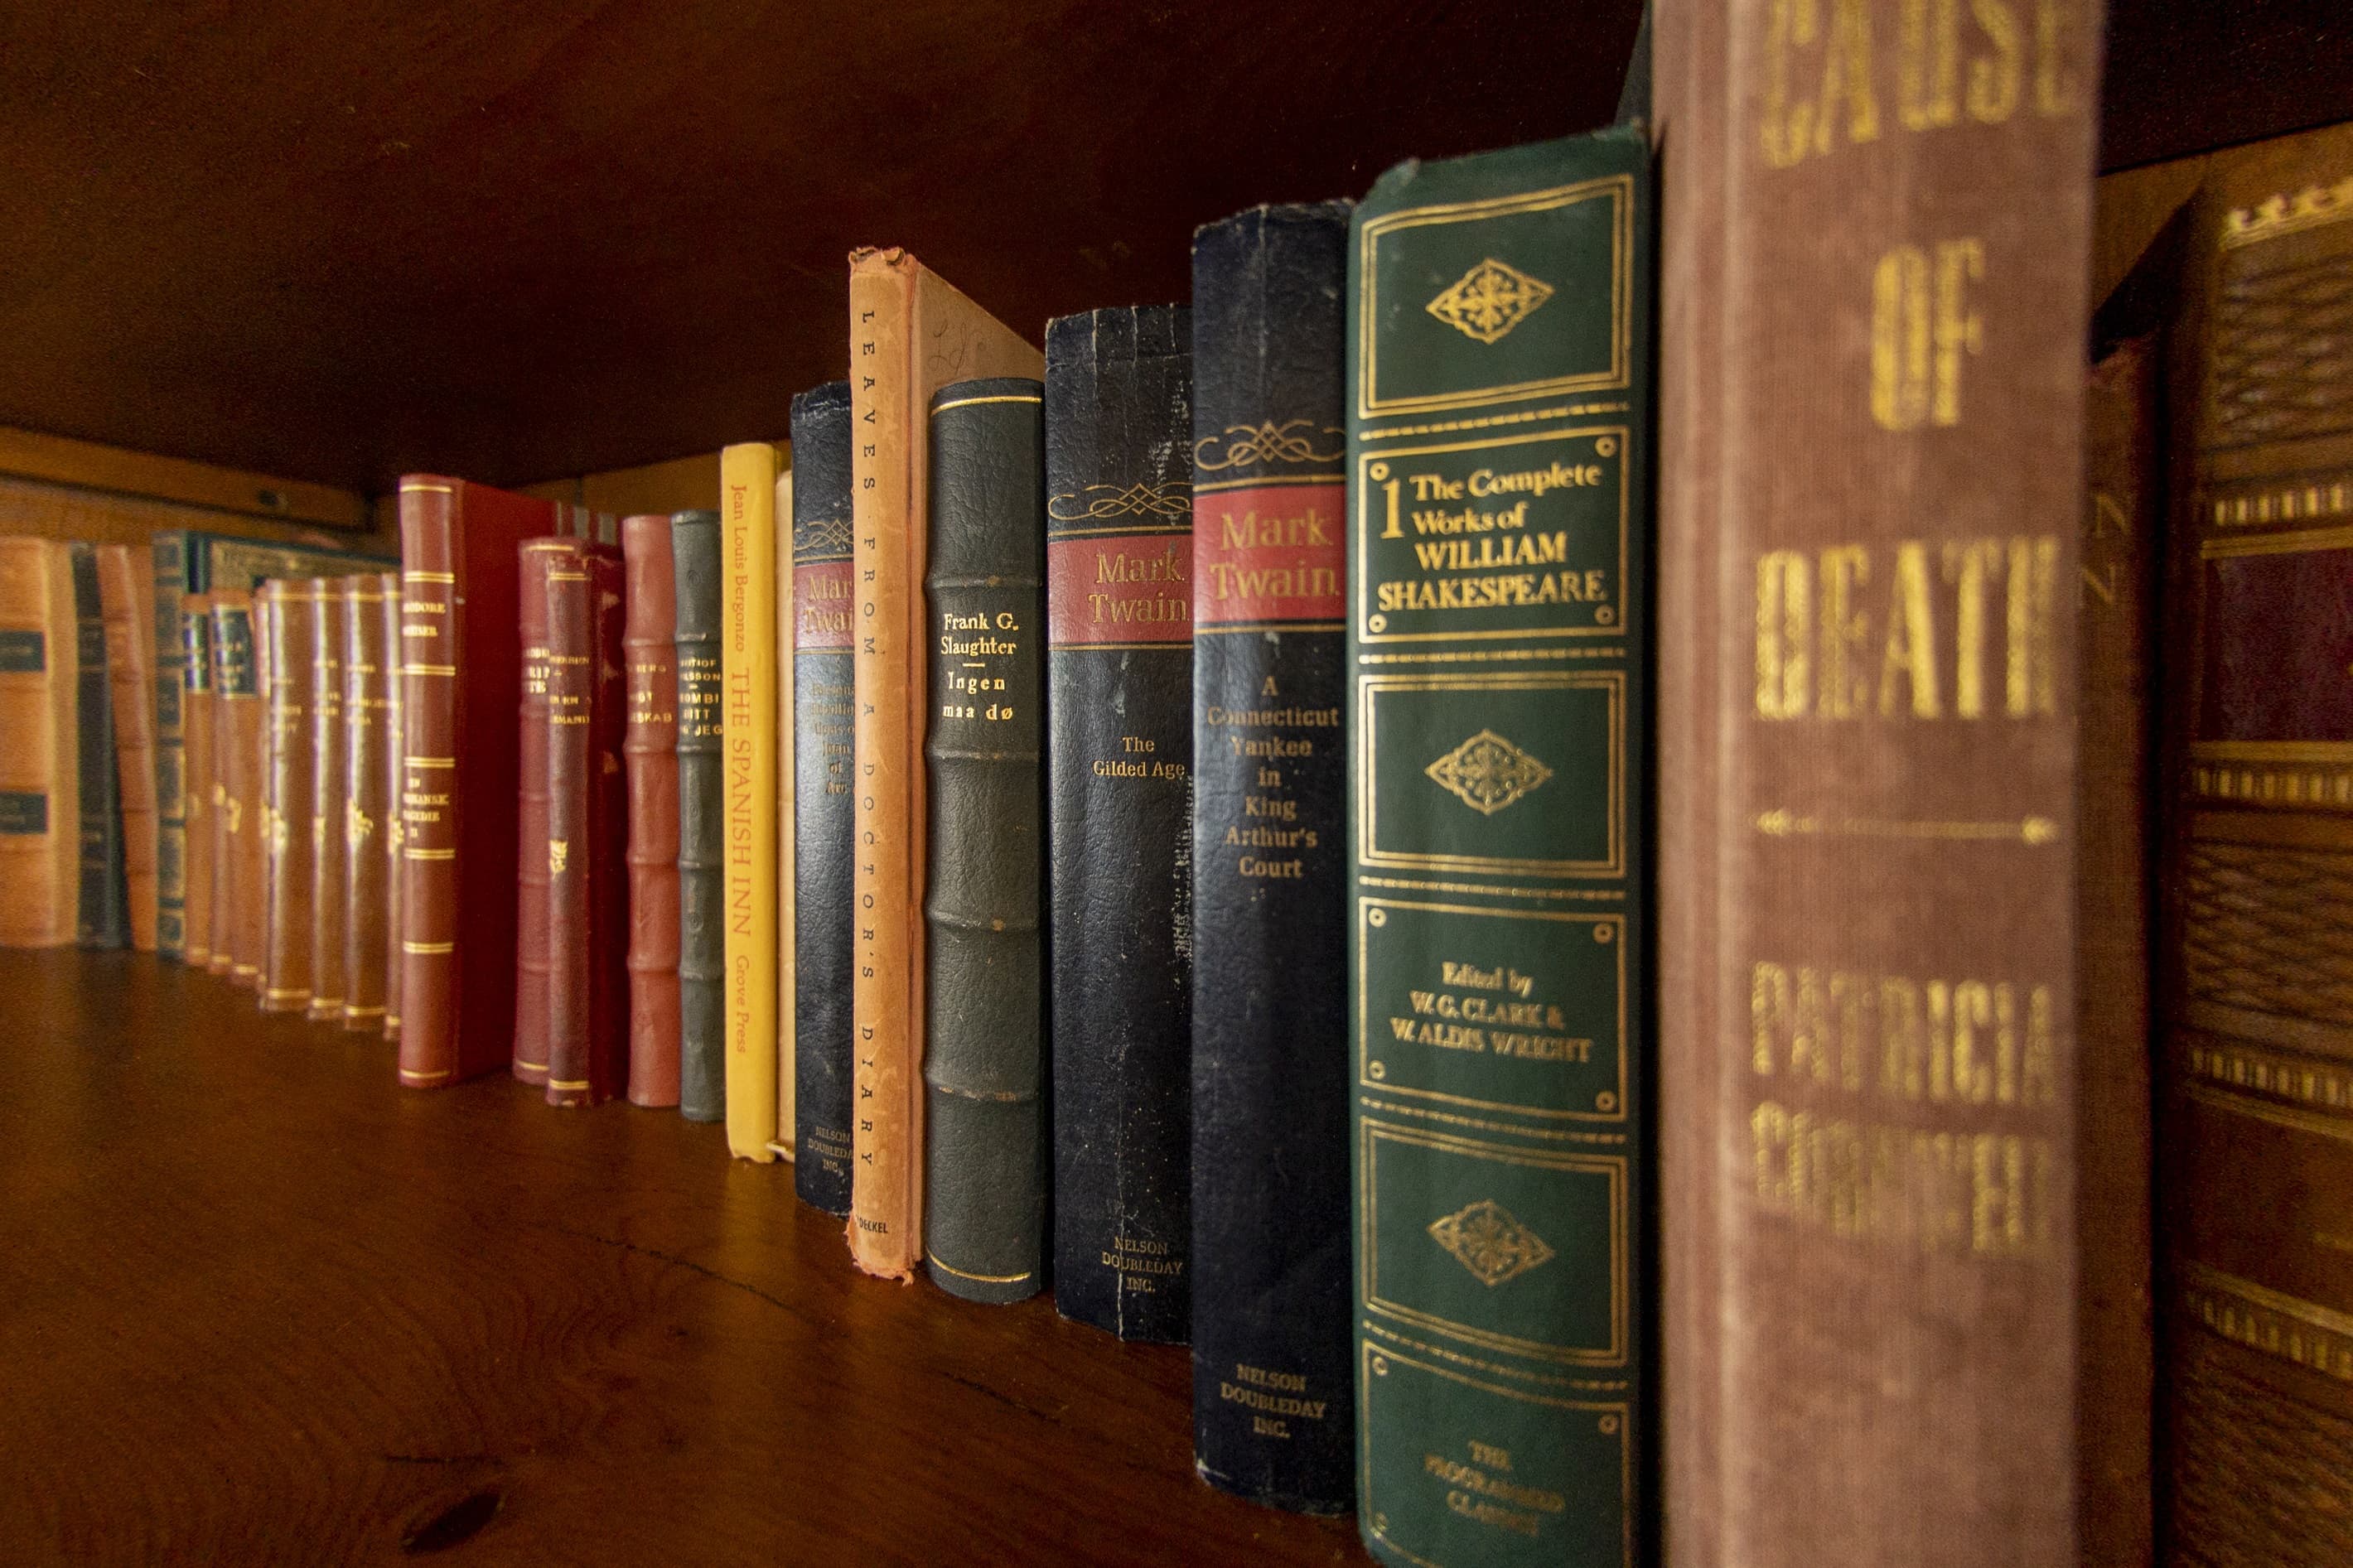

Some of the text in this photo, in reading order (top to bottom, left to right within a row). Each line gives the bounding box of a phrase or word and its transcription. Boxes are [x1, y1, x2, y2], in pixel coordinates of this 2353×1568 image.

[1758, 0, 2076, 166] CAUSE
[1871, 238, 1984, 431] OF
[1409, 461, 1602, 501] The Complete
[1380, 478, 1404, 539] 1
[1411, 500, 1530, 536] Works of
[1220, 508, 1333, 551] Mark
[1414, 531, 1568, 572] WILLIAM
[1095, 548, 1186, 584] Mark
[808, 576, 851, 602] Mar
[1209, 559, 1340, 601] Twain
[1378, 570, 1608, 612] SHAKESPEARE
[1088, 591, 1190, 623] Twain
[804, 607, 853, 634] Twai
[944, 612, 1019, 631] Frank G.
[1755, 534, 2061, 721] DEATH
[941, 635, 1017, 657] Slaughter
[948, 671, 1005, 694] Ingen
[1261, 676, 1279, 697] A
[943, 703, 1013, 721] maa dø
[1207, 706, 1339, 726] Connecticut
[694, 724, 722, 736] JEG
[861, 310, 876, 1166] LEAVES FROM A DOCTOR'S DIARY
[1123, 736, 1155, 752] The
[1230, 736, 1312, 757] Yankee
[732, 485, 751, 1054] Jean Louis Bergonzo THE SPANISH INN Grove Press
[1093, 760, 1186, 780] Gilded Age
[1259, 766, 1282, 787] in
[1245, 795, 1297, 821] King
[1224, 826, 1318, 848] Arthur's
[1239, 856, 1303, 880] Court
[1442, 961, 1533, 998] Edited by
[1751, 960, 2057, 1107] PATRICIA
[1489, 1030, 1594, 1064] WRIGHT
[815, 1126, 850, 1144] NELSON
[808, 1137, 853, 1160] DOUBLEDA
[1114, 1236, 1168, 1256] NELSON
[1102, 1251, 1183, 1276] DOUBLEDAY
[1127, 1276, 1156, 1292] INC.
[1236, 1363, 1307, 1392] NELSON
[1220, 1381, 1326, 1419] DOUBLEDAY
[1254, 1416, 1291, 1440] INC.
